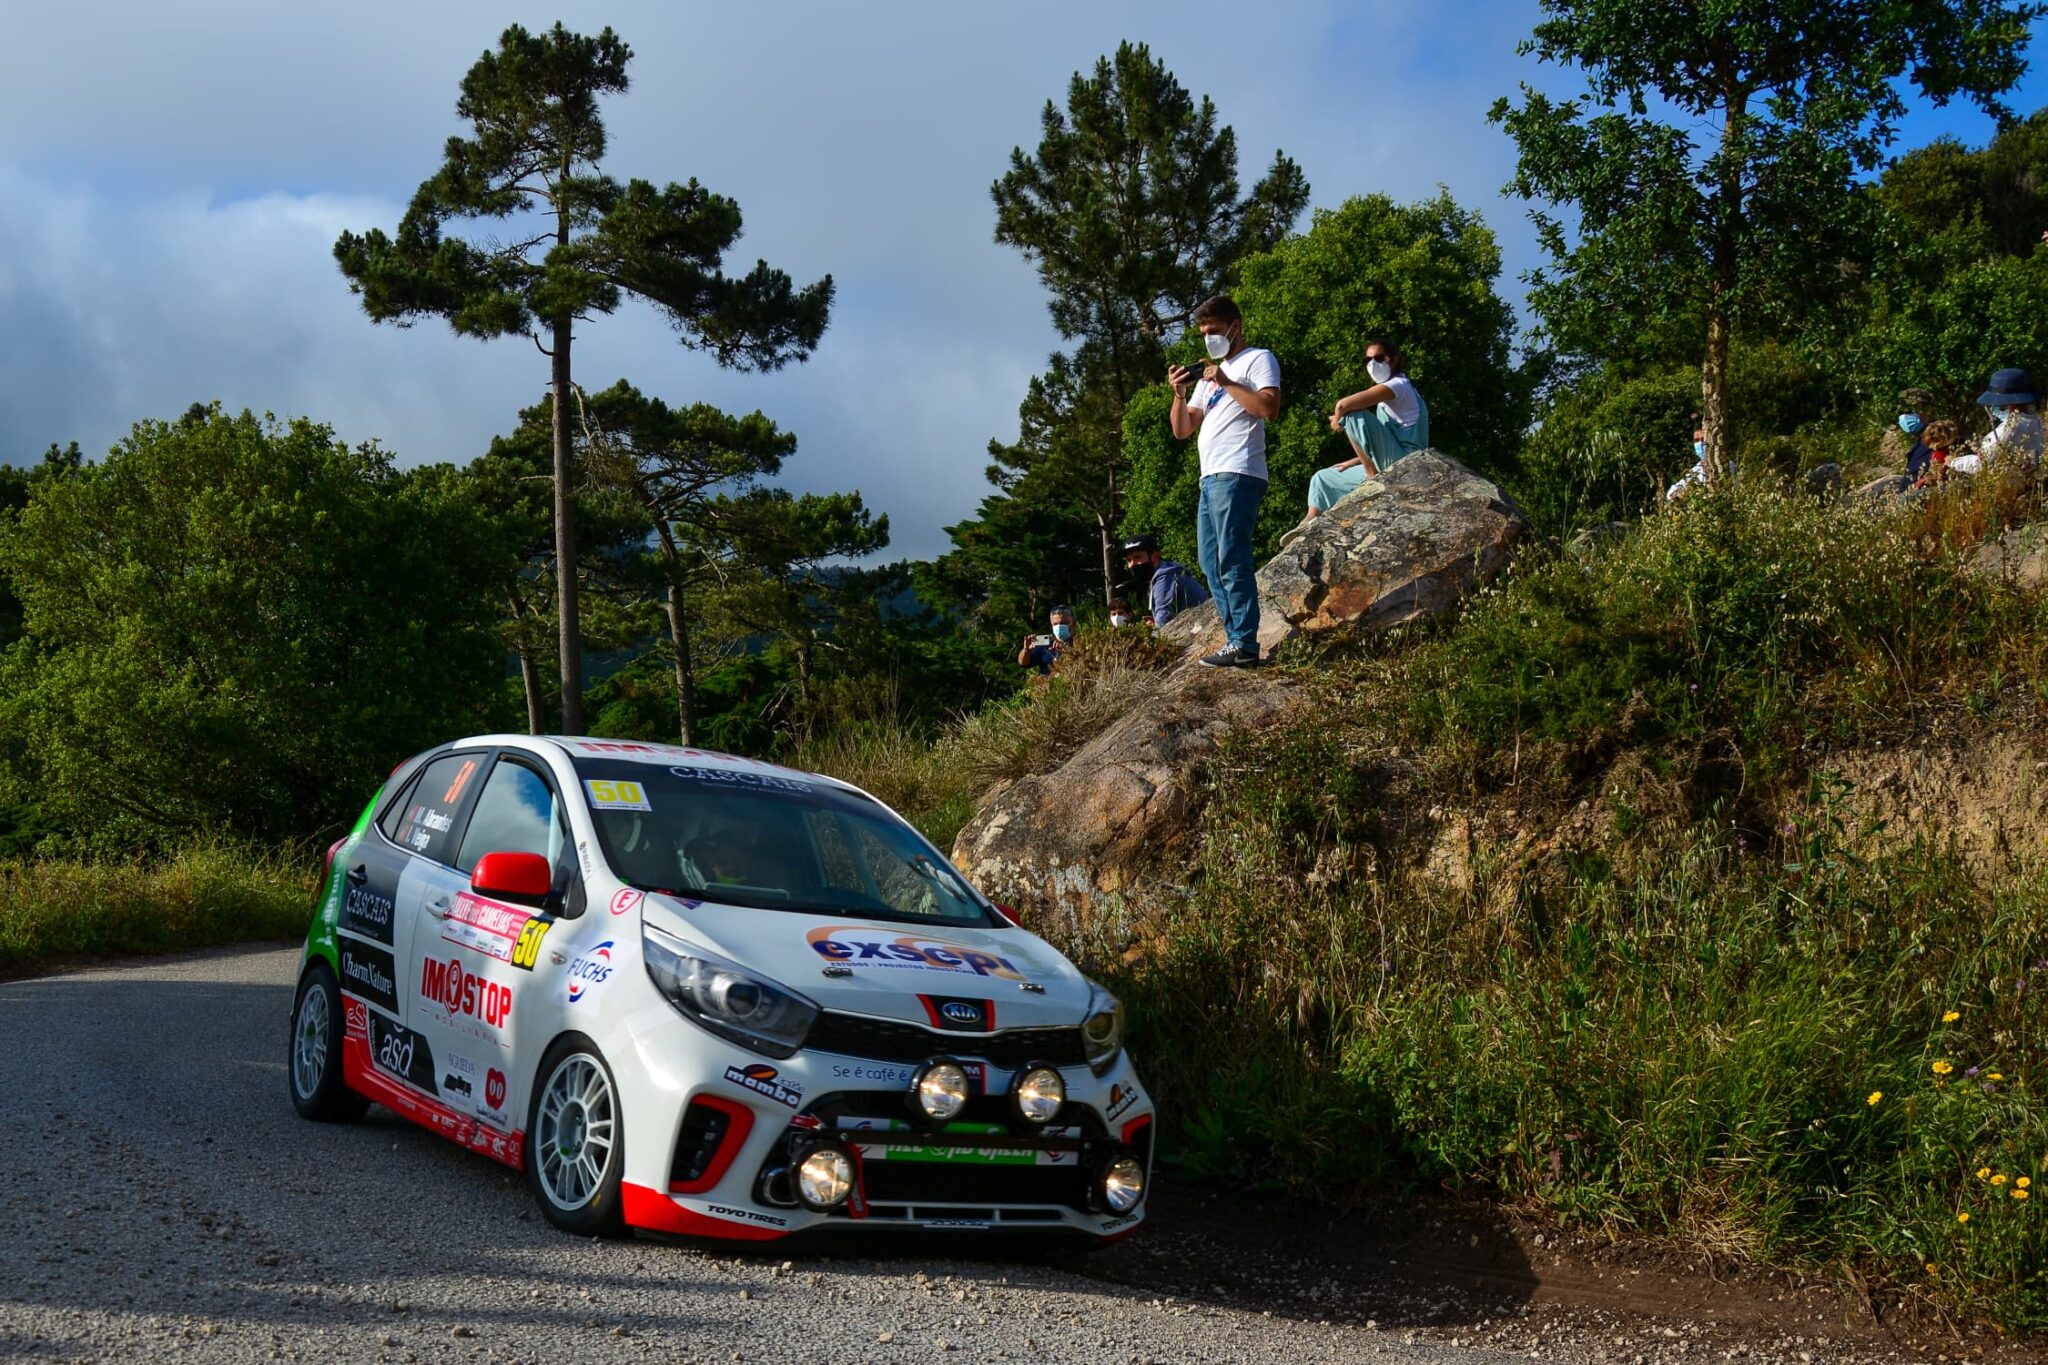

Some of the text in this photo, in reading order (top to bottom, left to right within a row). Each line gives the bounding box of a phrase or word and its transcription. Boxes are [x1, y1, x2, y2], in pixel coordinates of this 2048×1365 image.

[589, 780, 643, 803] 50
[669, 766, 813, 793] CASCAIS
[346, 889, 391, 926] CASCAIS
[616, 891, 634, 908] E
[513, 918, 550, 967] 50
[567, 958, 613, 983] FUCHS
[949, 1006, 978, 1019] KIA
[833, 1065, 850, 1078] Se
[854, 1067, 863, 1079] é
[867, 1068, 895, 1082] café
[727, 1069, 800, 1107] mambo
